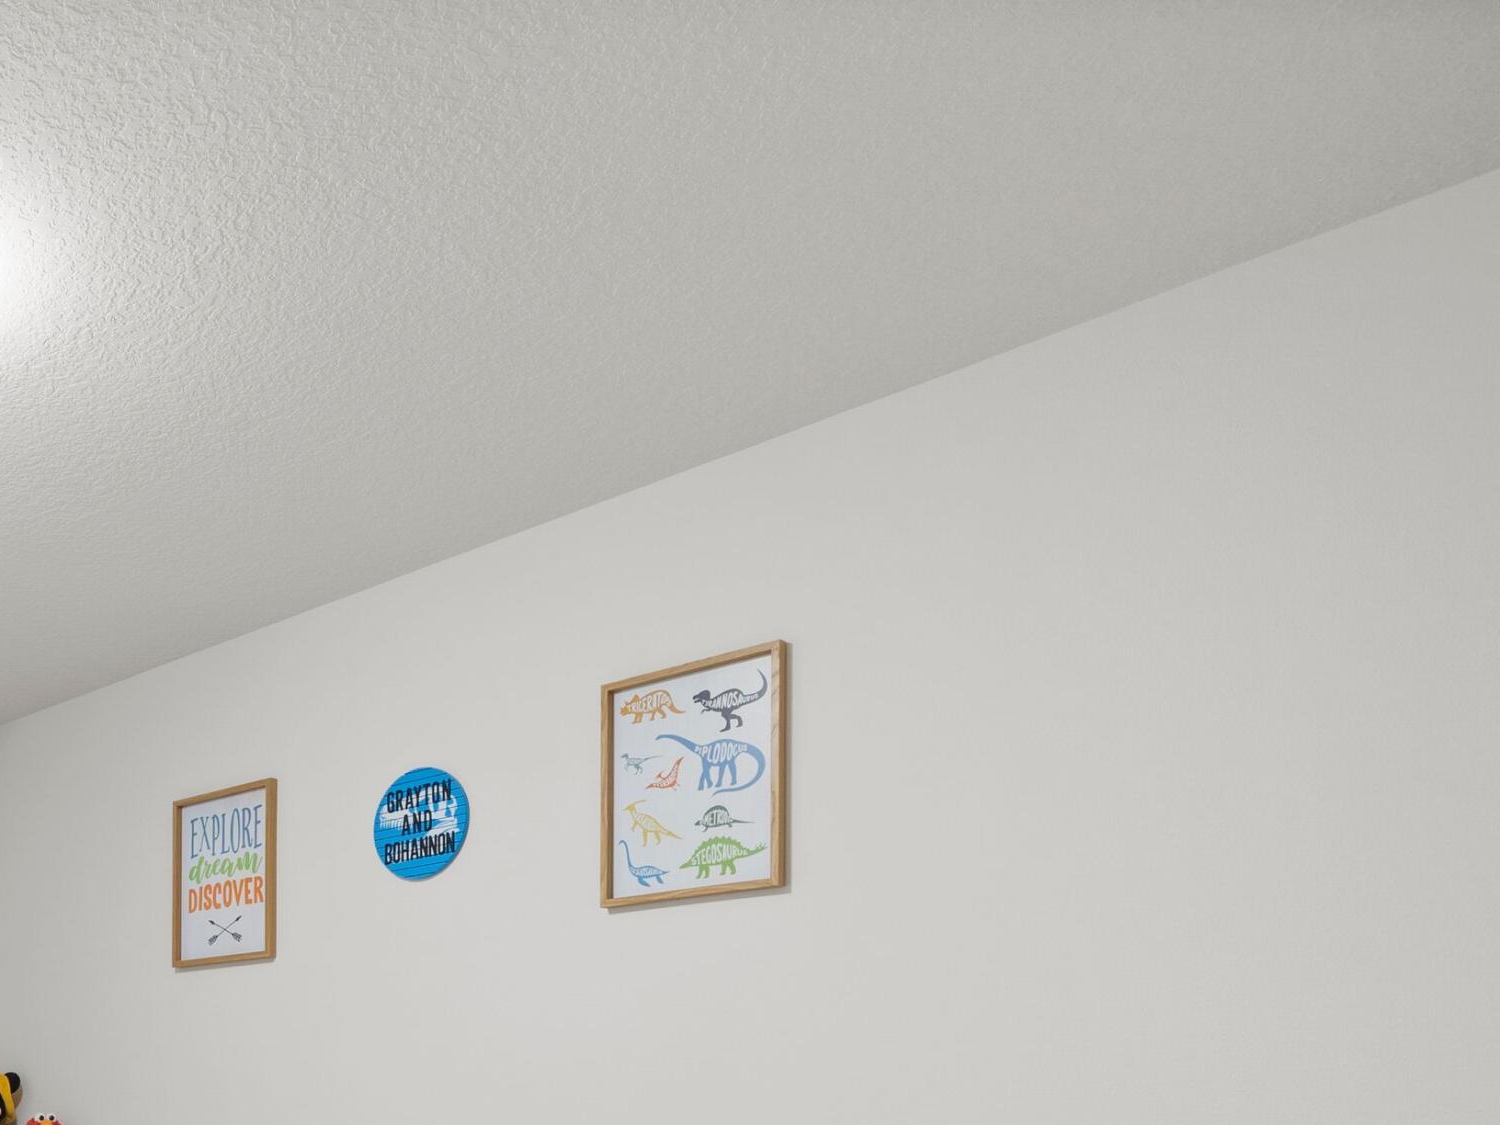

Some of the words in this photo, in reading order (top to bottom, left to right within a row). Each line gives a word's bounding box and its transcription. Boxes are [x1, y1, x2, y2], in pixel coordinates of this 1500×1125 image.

[386, 778, 452, 814] GRAYTON
[190, 803, 263, 860] EXPLORE
[401, 809, 433, 837] AND
[384, 830, 456, 866] BOHANNON
[188, 851, 263, 885] dream
[188, 876, 264, 914] DISCOVER
